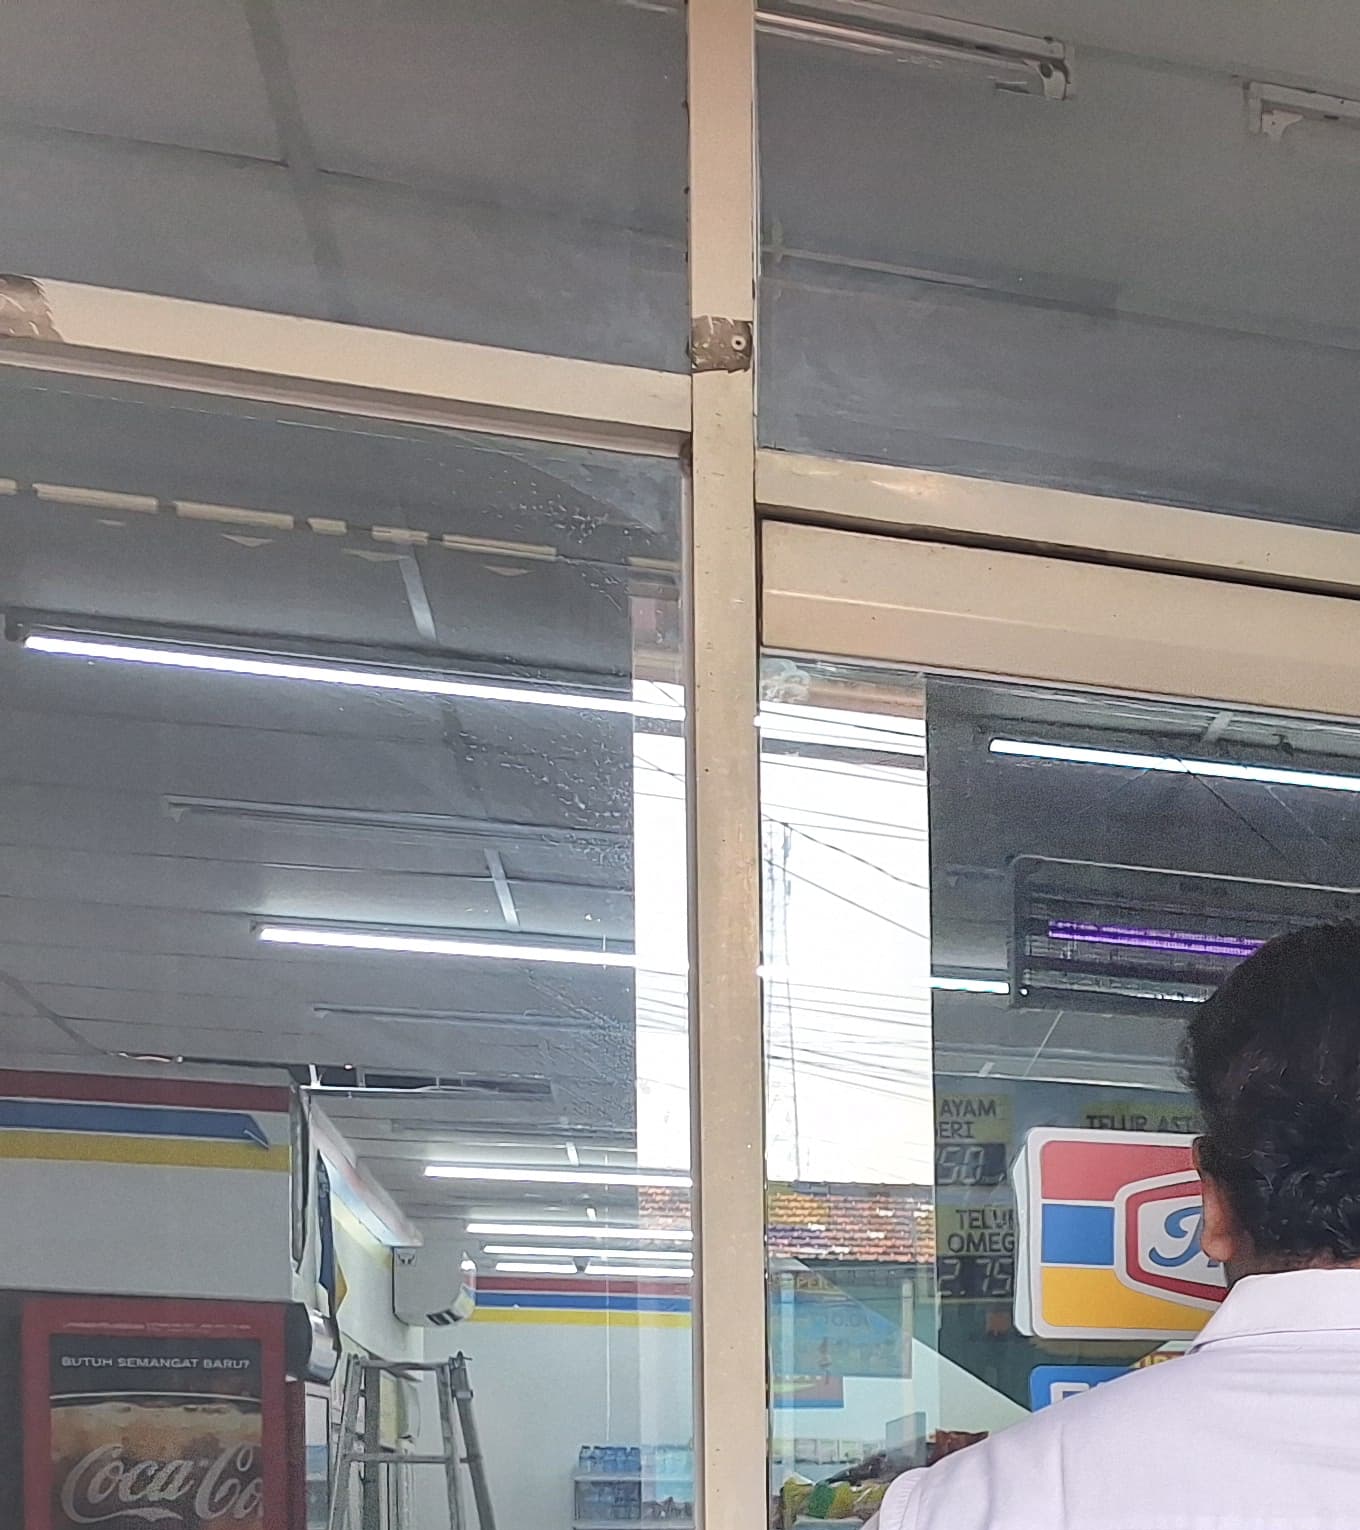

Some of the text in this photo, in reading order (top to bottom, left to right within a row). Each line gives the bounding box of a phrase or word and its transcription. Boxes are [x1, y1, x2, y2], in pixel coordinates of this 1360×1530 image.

[940, 1100, 997, 1118] AYAM
[61, 1356, 250, 1370] BUTUH SEMANGAT BARU?
